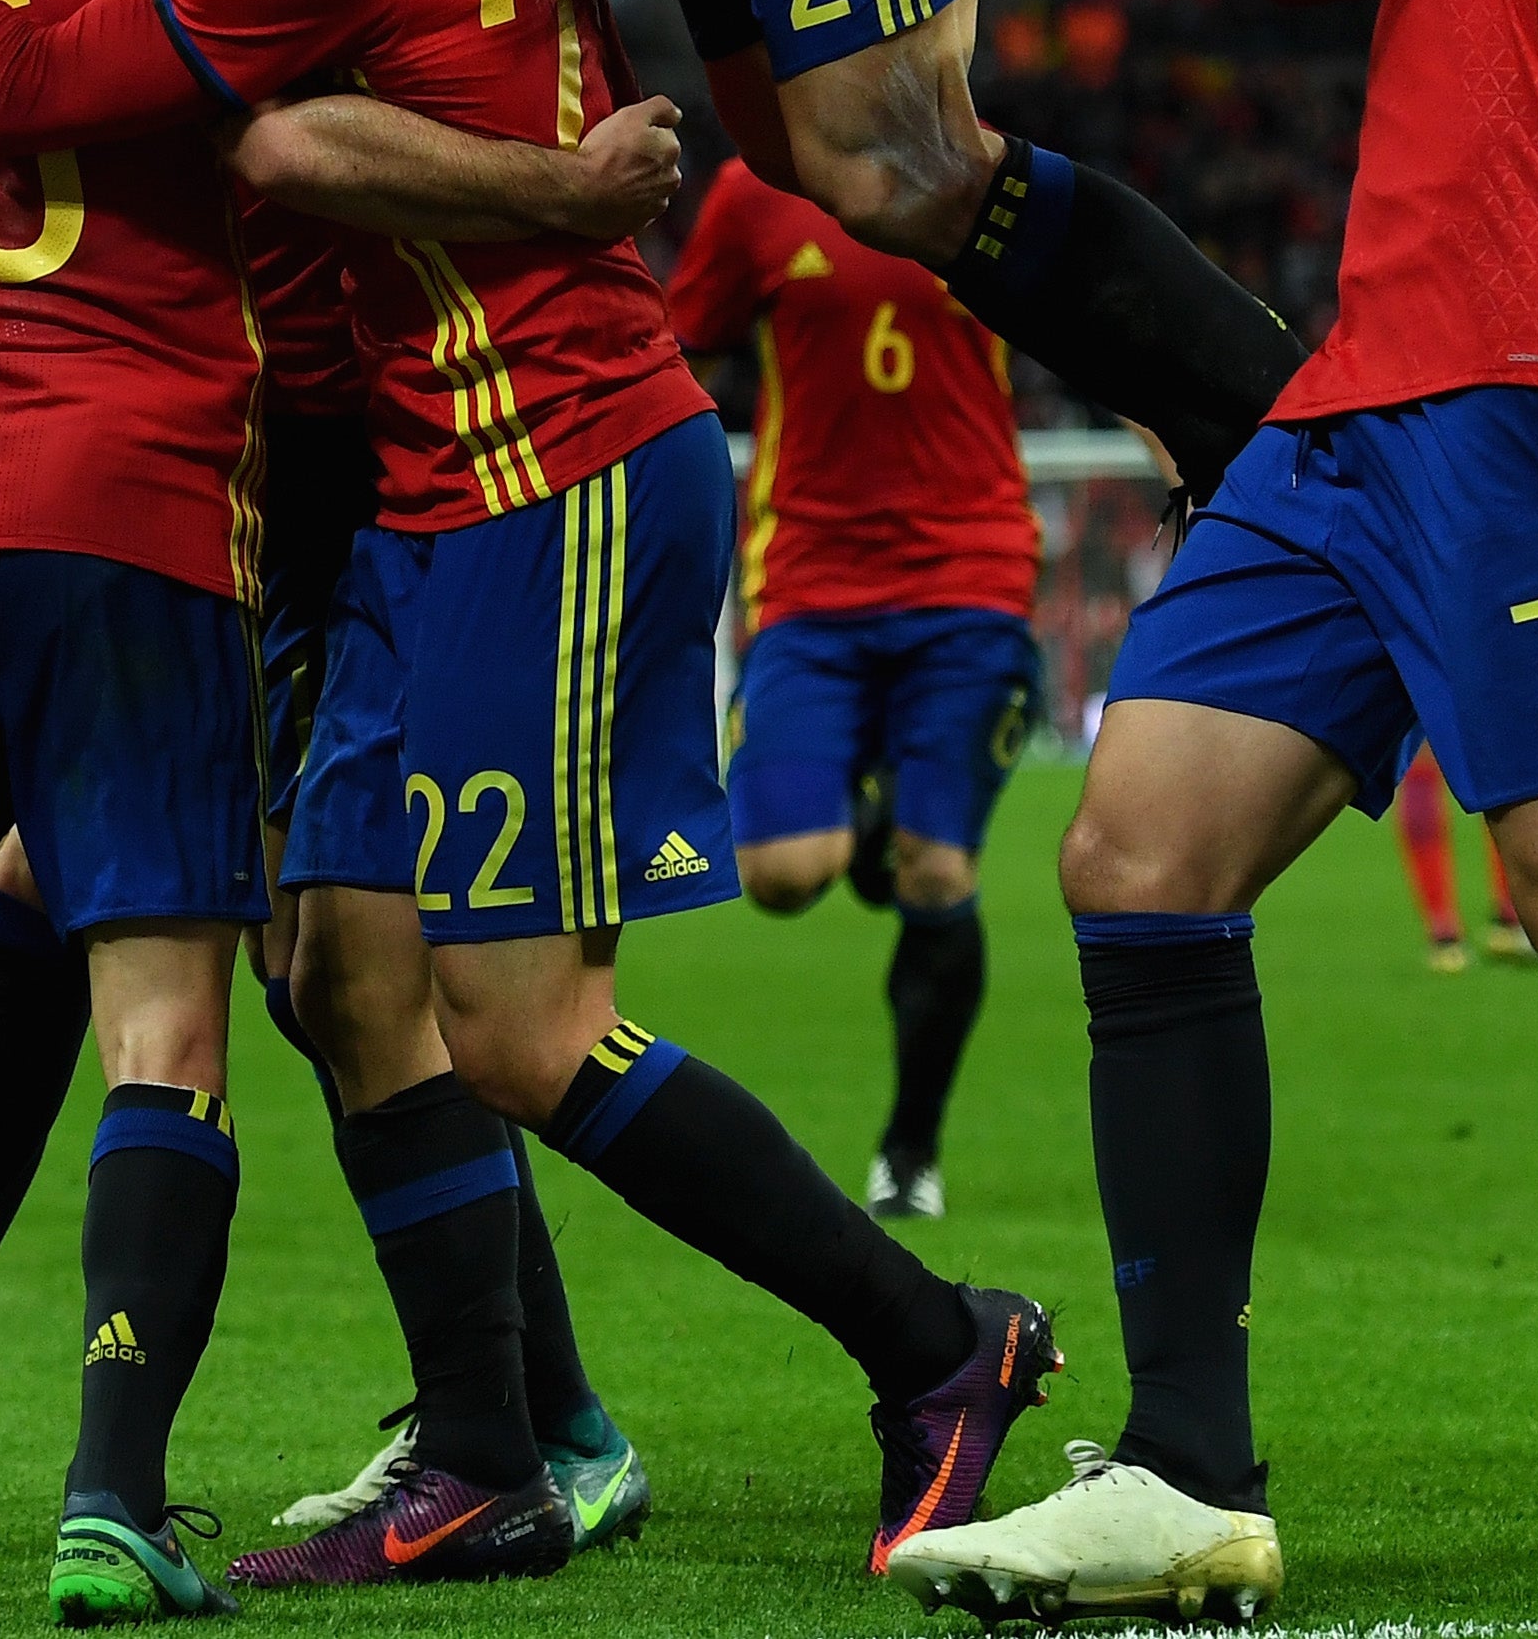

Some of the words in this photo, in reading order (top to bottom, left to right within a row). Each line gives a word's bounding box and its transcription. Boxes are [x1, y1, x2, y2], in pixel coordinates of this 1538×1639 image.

[863, 302, 915, 394] 6
[404, 769, 535, 911] 22
[644, 857, 710, 881] adidas
[85, 1341, 147, 1366] adidas
[998, 1312, 1023, 1390] MERCURIAL
